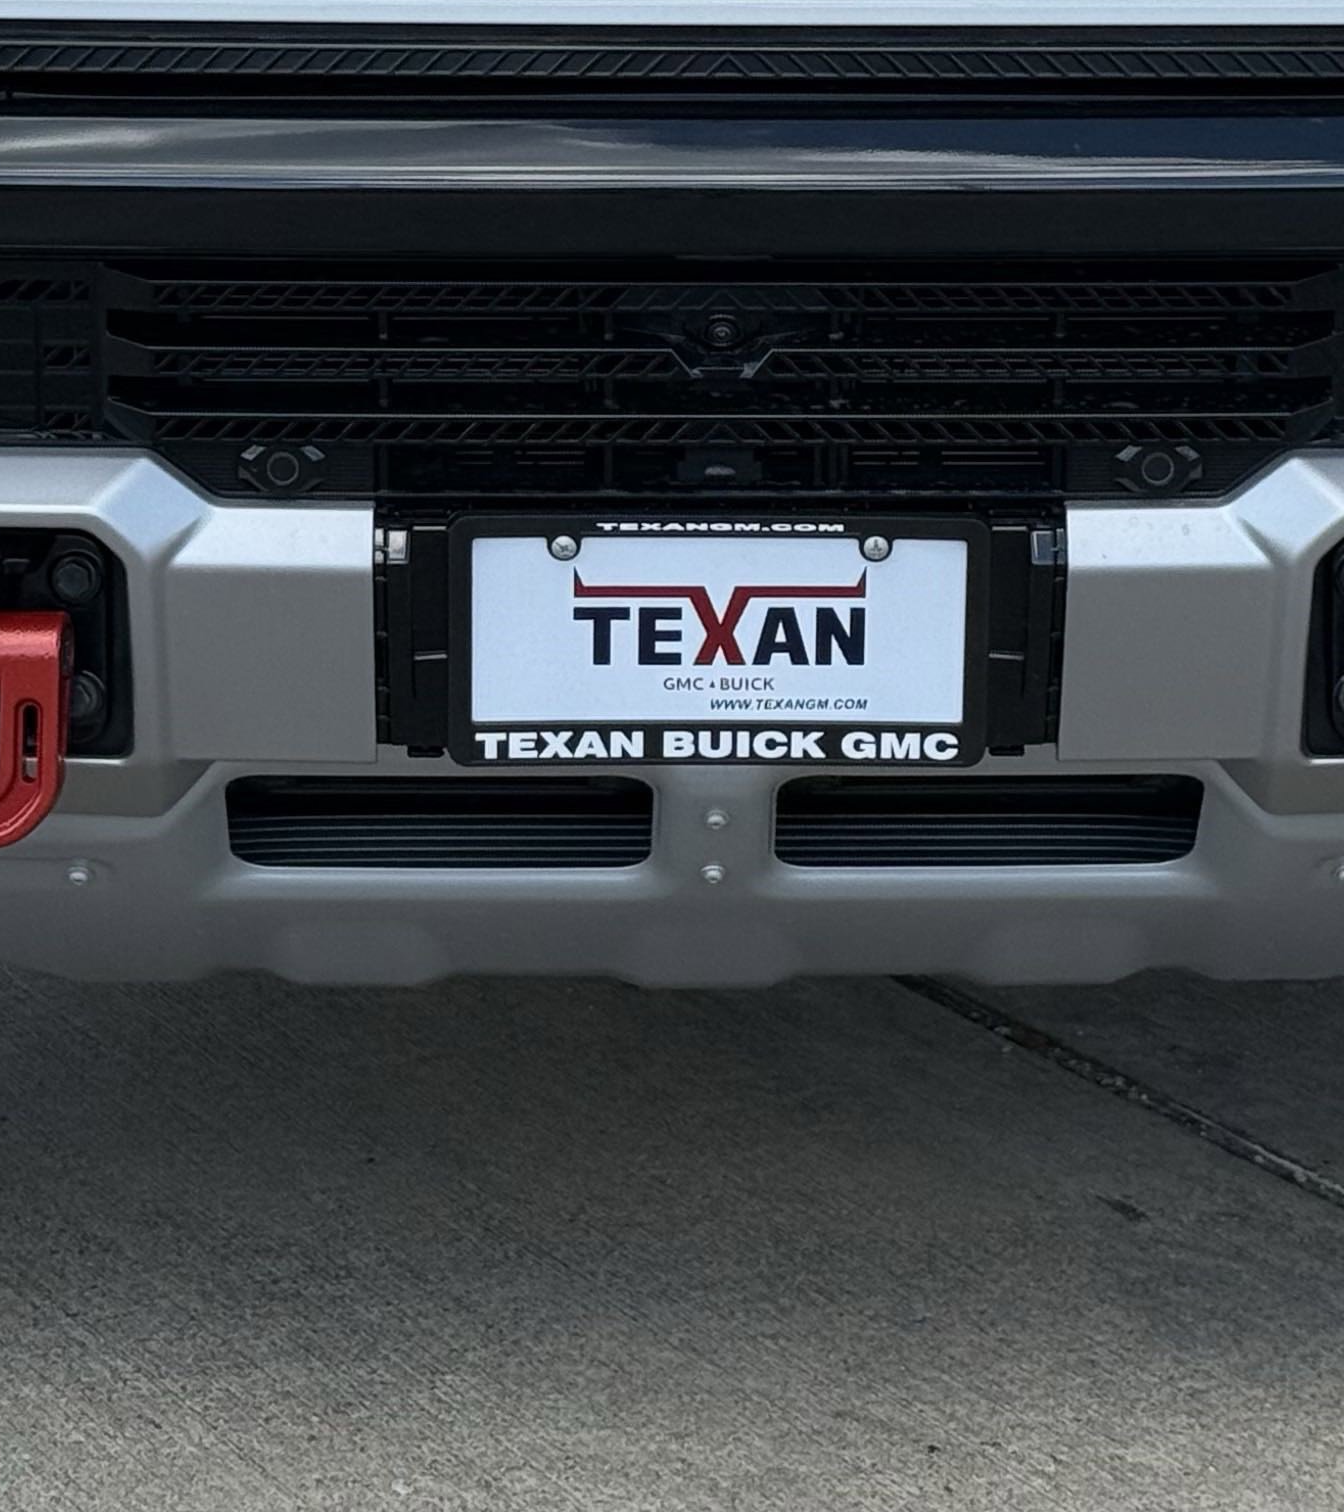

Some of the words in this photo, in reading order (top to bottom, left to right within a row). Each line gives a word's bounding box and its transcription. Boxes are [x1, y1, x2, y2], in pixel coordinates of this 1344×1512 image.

[596, 522, 844, 532] TEXANGM.COM
[573, 586, 866, 665] TEXAN
[663, 677, 704, 691] GMC
[720, 677, 775, 691] BUICK
[710, 698, 868, 711] WWW.TEXANGM.COM
[476, 732, 644, 759] TEXAN
[663, 732, 826, 759] BUICK
[841, 731, 959, 760] GMC
